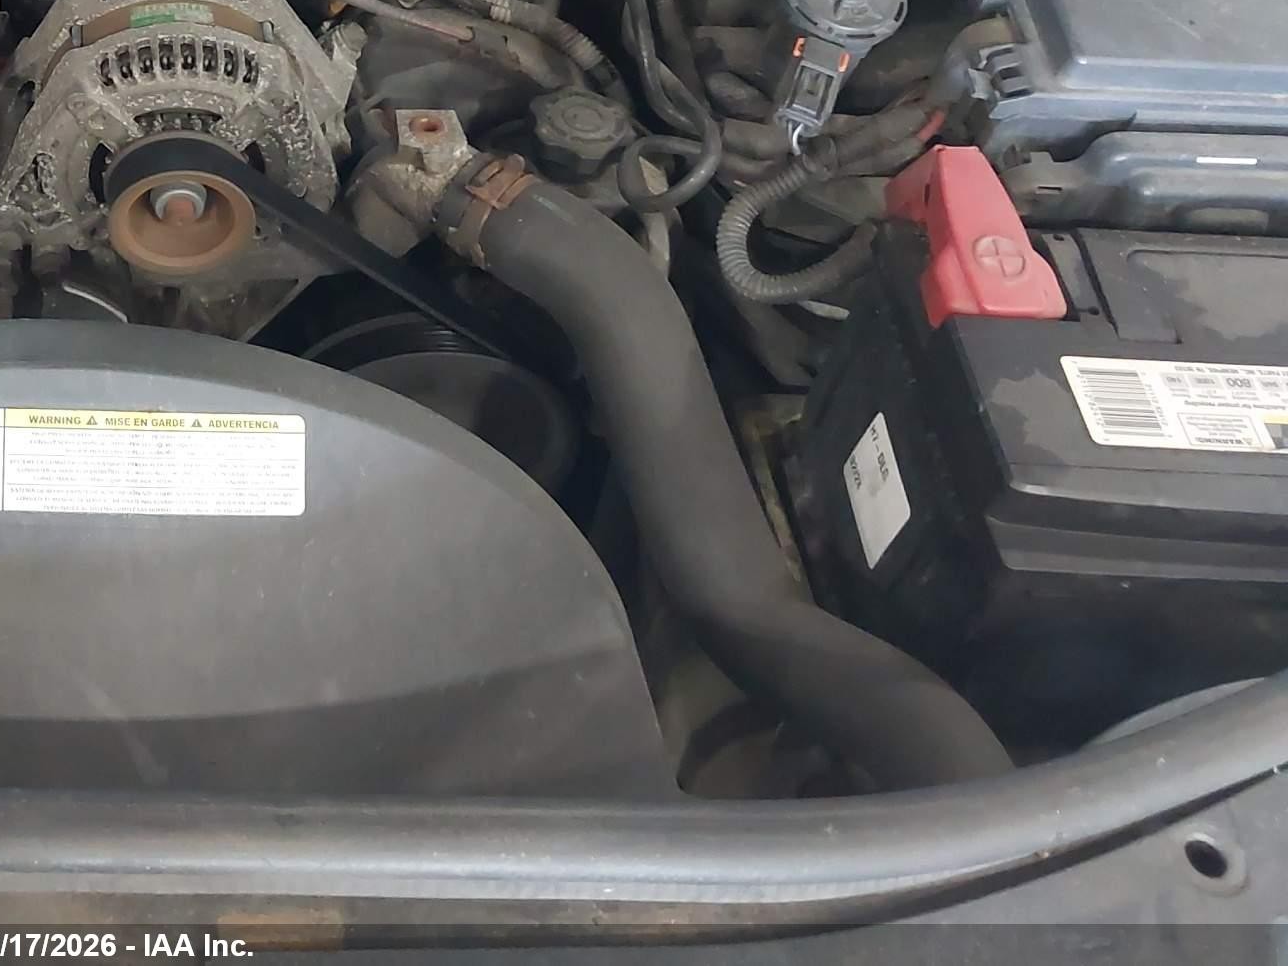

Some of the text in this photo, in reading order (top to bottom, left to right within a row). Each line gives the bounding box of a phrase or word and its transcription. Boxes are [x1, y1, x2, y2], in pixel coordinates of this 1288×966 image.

[28, 414, 82, 425] WARNING
[105, 416, 185, 428] MISE EN GARDE
[208, 419, 280, 429] ADVERTENCIA
